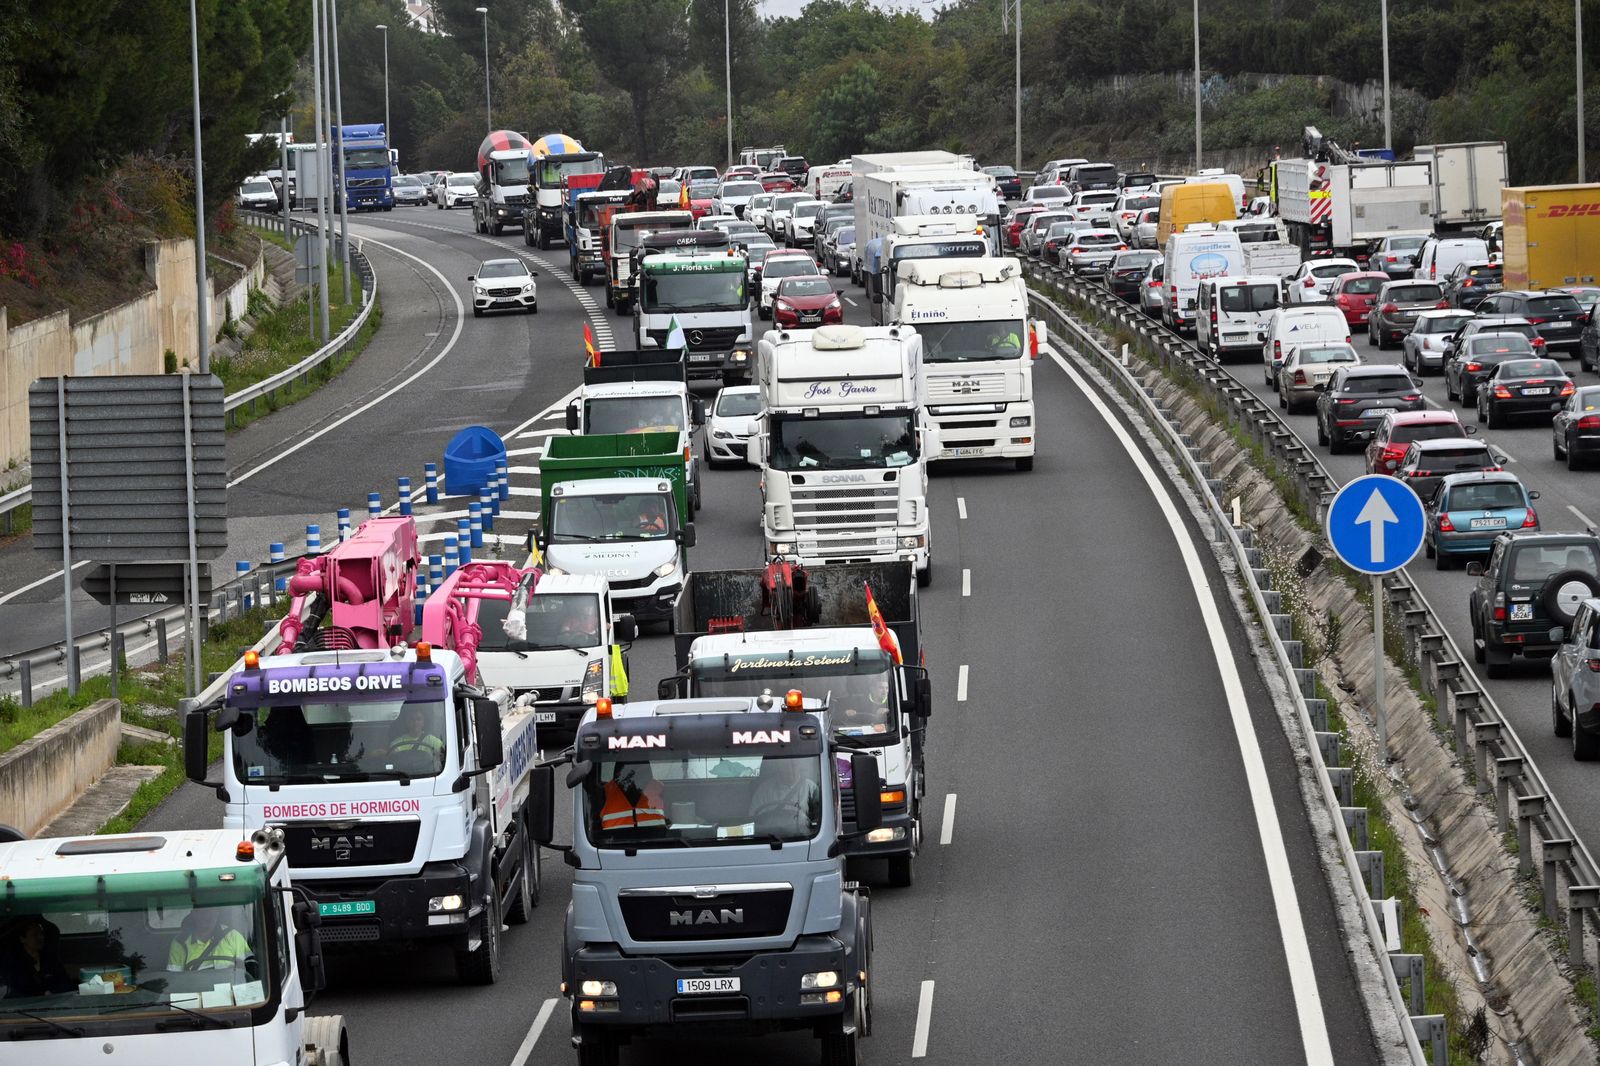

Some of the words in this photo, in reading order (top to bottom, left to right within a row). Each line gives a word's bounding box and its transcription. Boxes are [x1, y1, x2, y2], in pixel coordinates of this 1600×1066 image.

[911, 311, 920, 319] El
[803, 381, 832, 399] José
[821, 474, 866, 483] SCANIA
[804, 653, 851, 666] Setenil
[268, 676, 352, 694] BOMBEOS
[355, 675, 403, 690] ORVE
[539, 713, 555, 722] LHY
[608, 734, 666, 750] MAN
[732, 730, 791, 745] MAN
[263, 803, 327, 818] BOMBEOS
[330, 803, 347, 815] DE
[350, 800, 420, 814] HORMIGON
[311, 835, 374, 850] MAN
[322, 904, 328, 912] P
[669, 908, 744, 926] MAN
[686, 980, 711, 991] 1509
[714, 979, 734, 990] LRX
